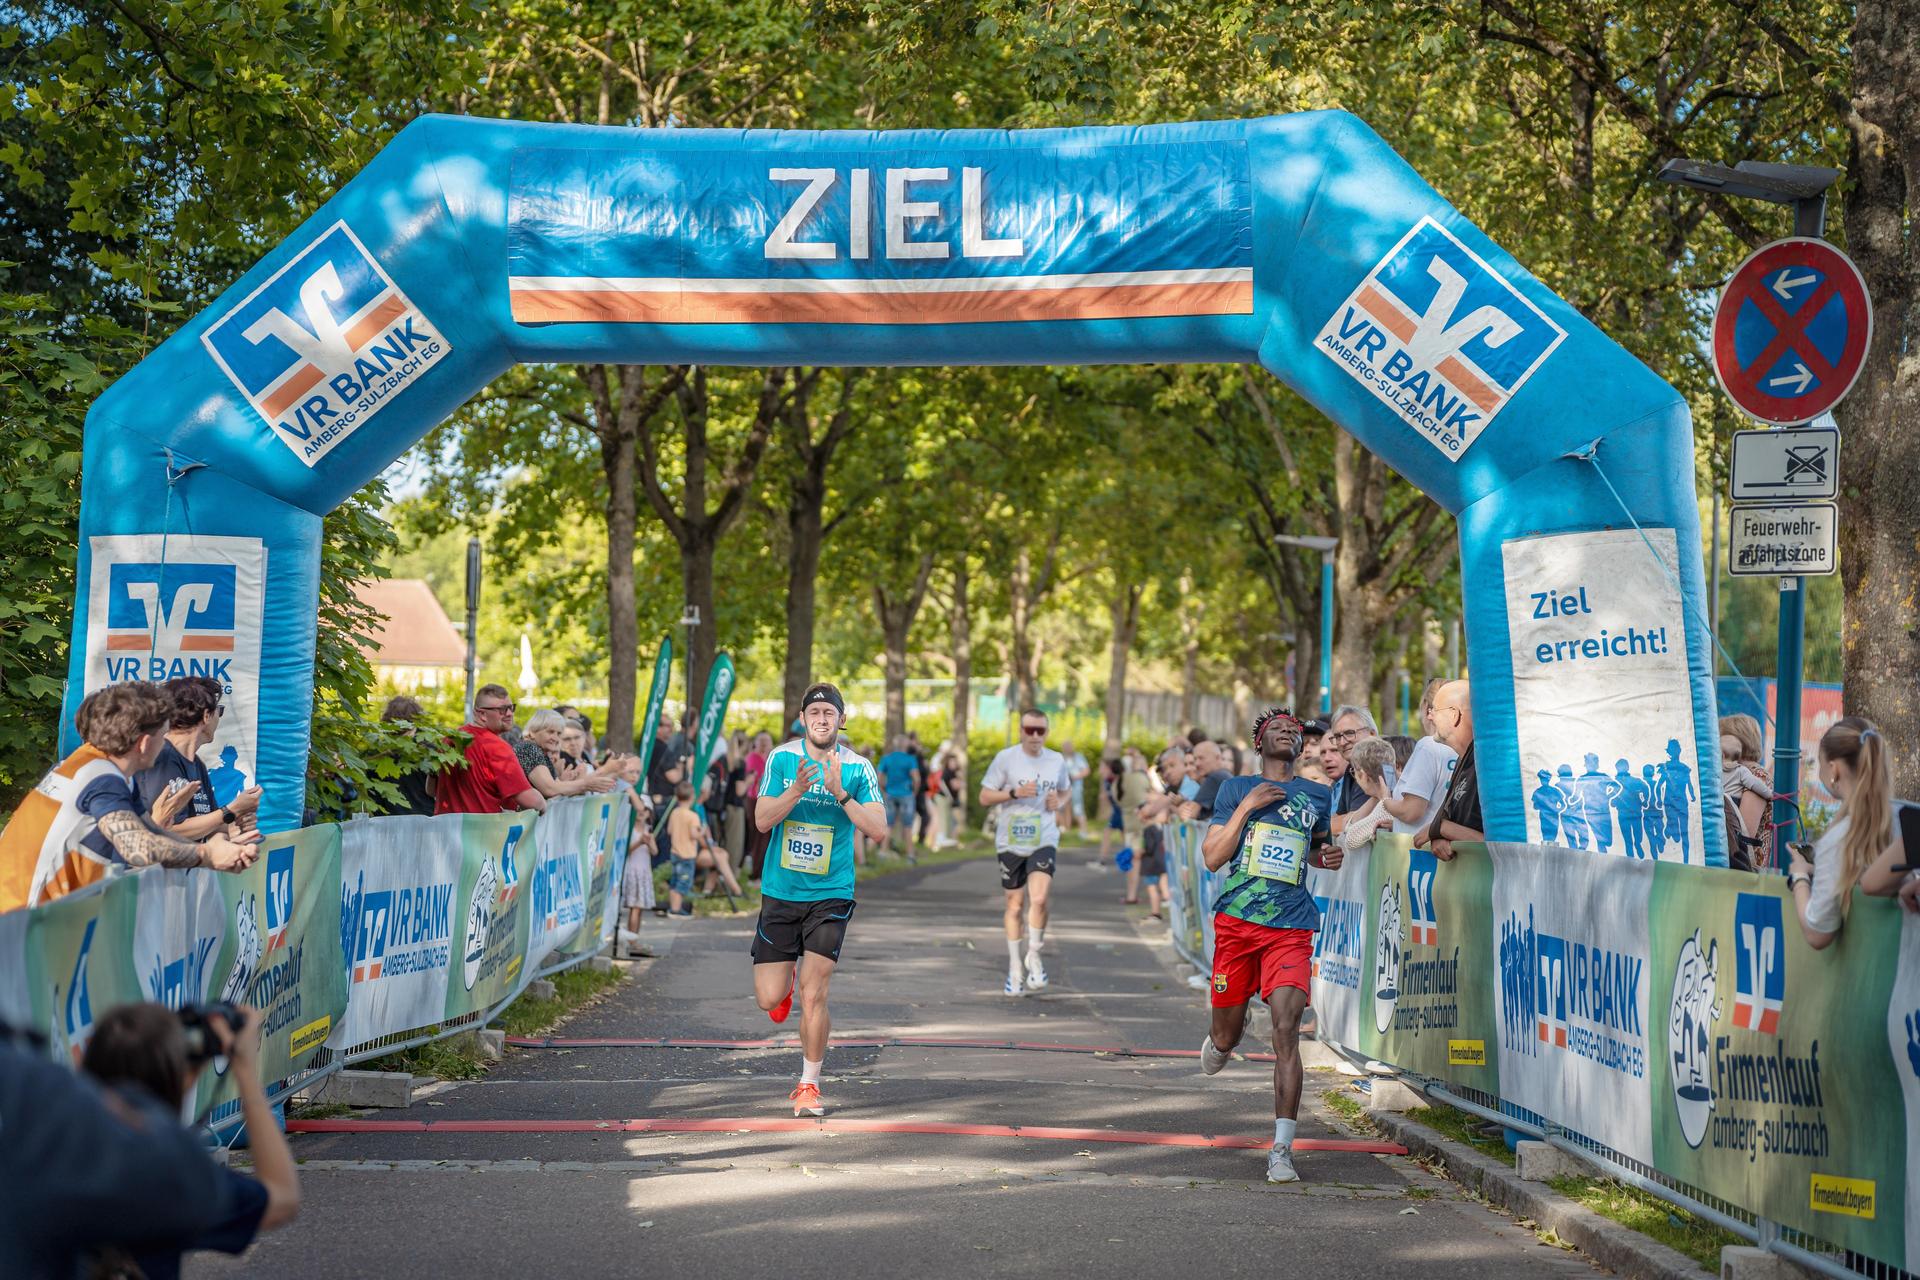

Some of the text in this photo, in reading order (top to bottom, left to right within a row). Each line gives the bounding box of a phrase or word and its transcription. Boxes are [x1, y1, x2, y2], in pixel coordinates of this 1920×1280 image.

[765, 166, 1024, 259] ZIEL
[278, 316, 432, 441] VR BANK
[304, 341, 440, 457] AMBERG-SULZBACH EG
[1322, 335, 1460, 451] AMBERG-SULZBACH EG
[1338, 305, 1482, 441] VR BANK
[1744, 516, 1821, 536] Feuerwehr-
[1531, 586, 1592, 619] Ziel
[106, 657, 233, 682] VR BANK
[1536, 627, 1667, 663] erreicht!
[700, 693, 721, 756] AOK
[788, 839, 824, 857] 1893
[1260, 844, 1294, 863] 522
[390, 883, 453, 947] VR BANK
[381, 947, 440, 977] AMBERG-SULZBACH
[1401, 946, 1459, 996] Firmenlauf
[1566, 941, 1642, 1037] VR BANK
[1394, 996, 1458, 1038] amberg-sulzbach
[1568, 1024, 1643, 1078] AMBERG-SULZBACH EG
[1716, 1035, 1824, 1107] Firmenlauf
[1713, 1107, 1829, 1163] amberg-sulzbach
[1814, 1183, 1873, 1213] firmenlauf.bayern
